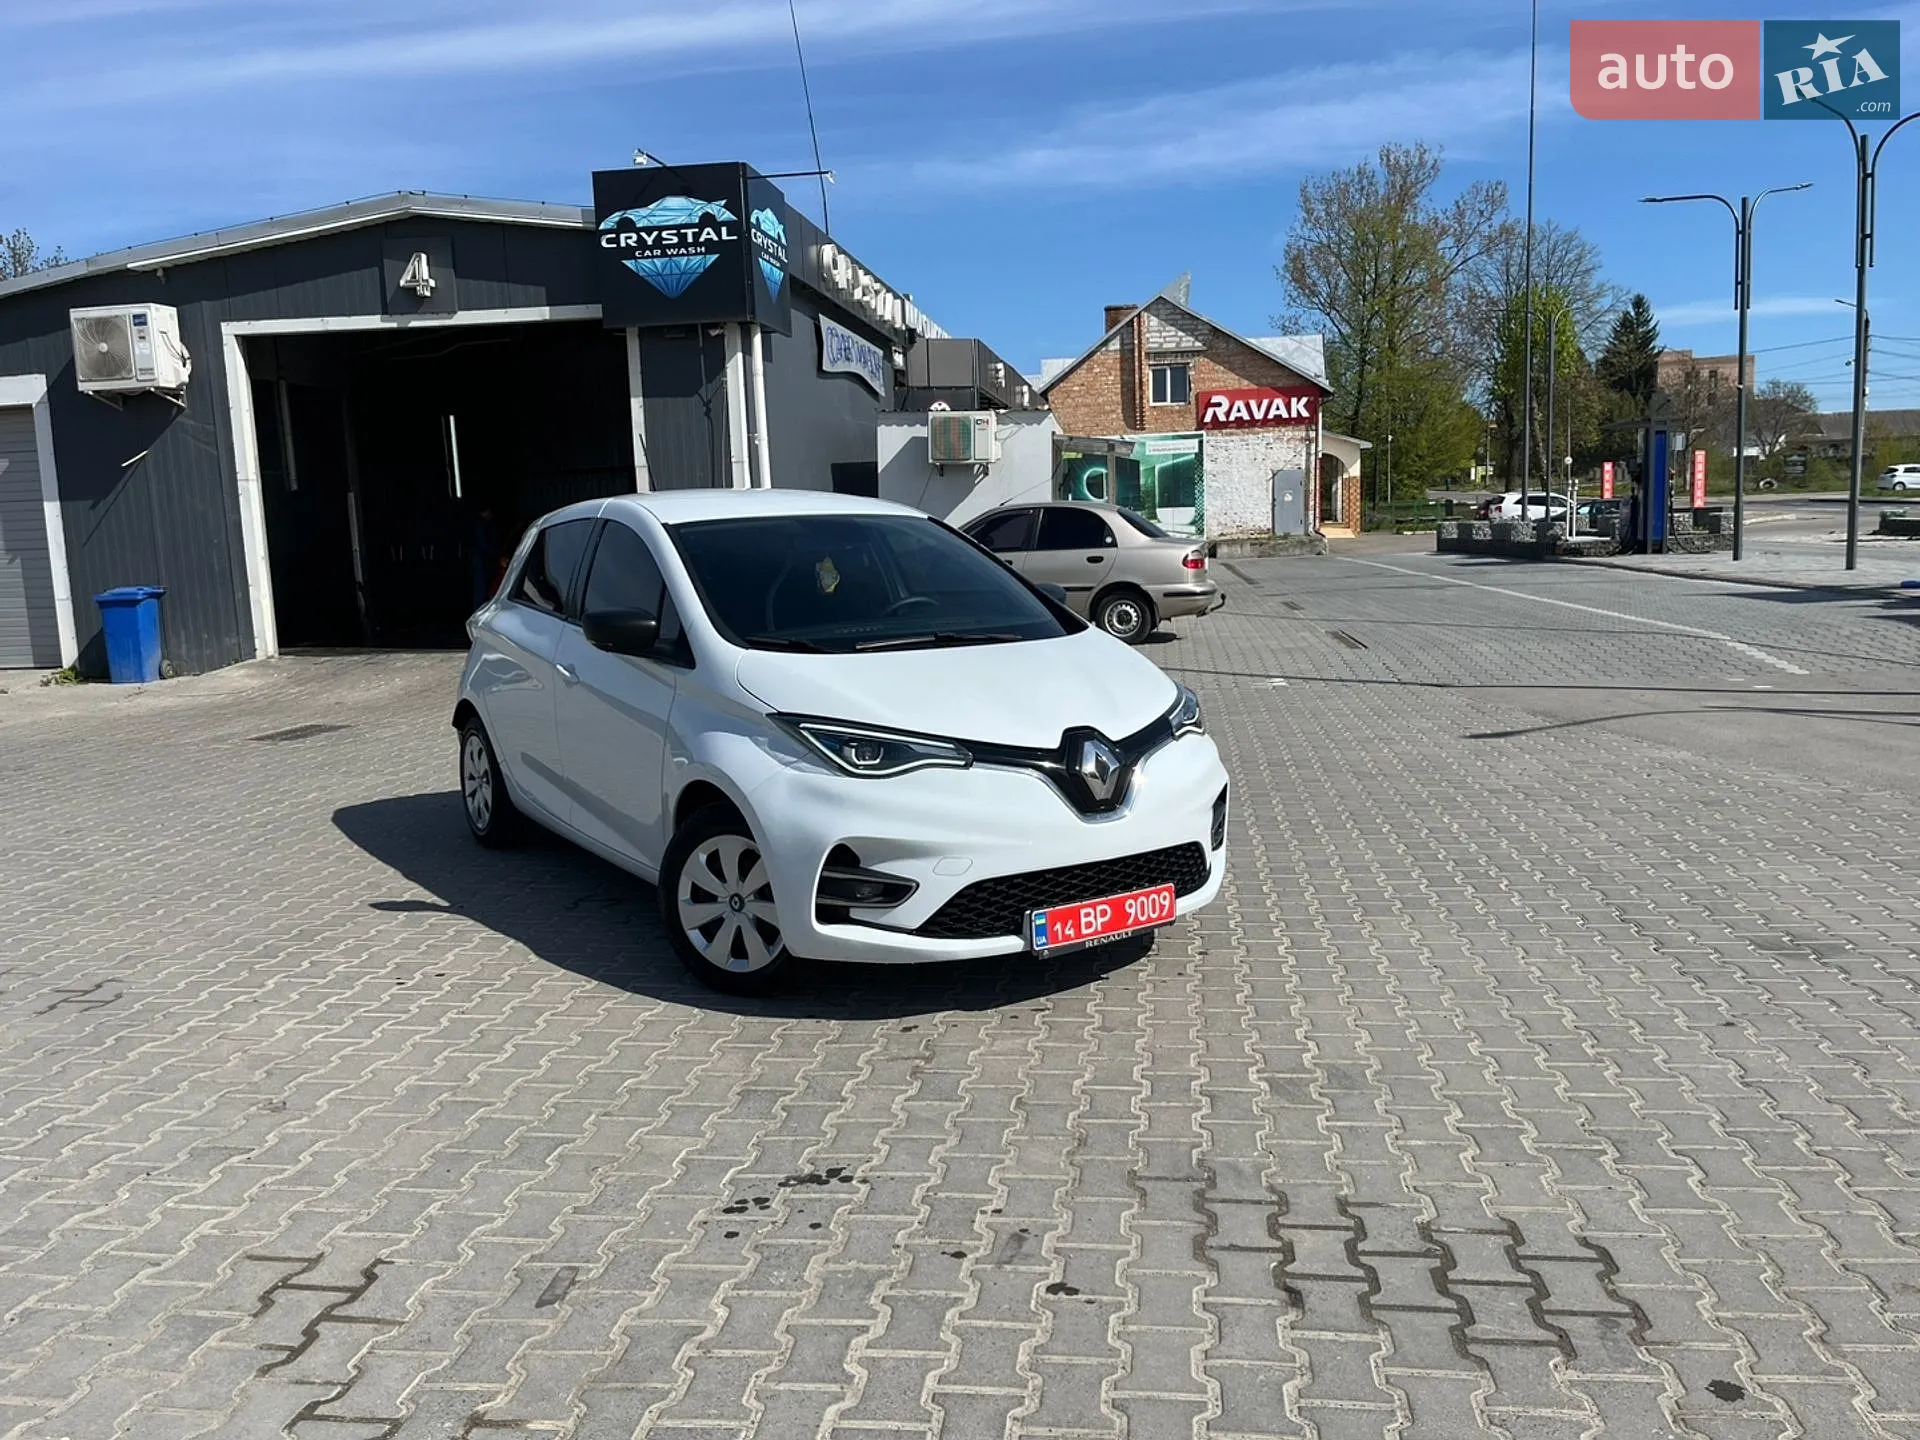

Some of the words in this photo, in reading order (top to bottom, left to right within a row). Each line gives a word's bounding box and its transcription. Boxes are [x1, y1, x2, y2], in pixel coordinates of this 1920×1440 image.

[600, 226, 738, 248] CRYSTAL
[750, 228, 788, 263] CRYSTAL
[635, 249, 661, 257] CAR
[666, 246, 706, 256] WASH
[399, 252, 436, 297] 4
[1203, 395, 1311, 423] RAVAK
[1052, 919, 1075, 941] 14
[1079, 904, 1112, 935] BP
[1124, 891, 1171, 926] 9009
[1085, 930, 1133, 948] RENAULT
